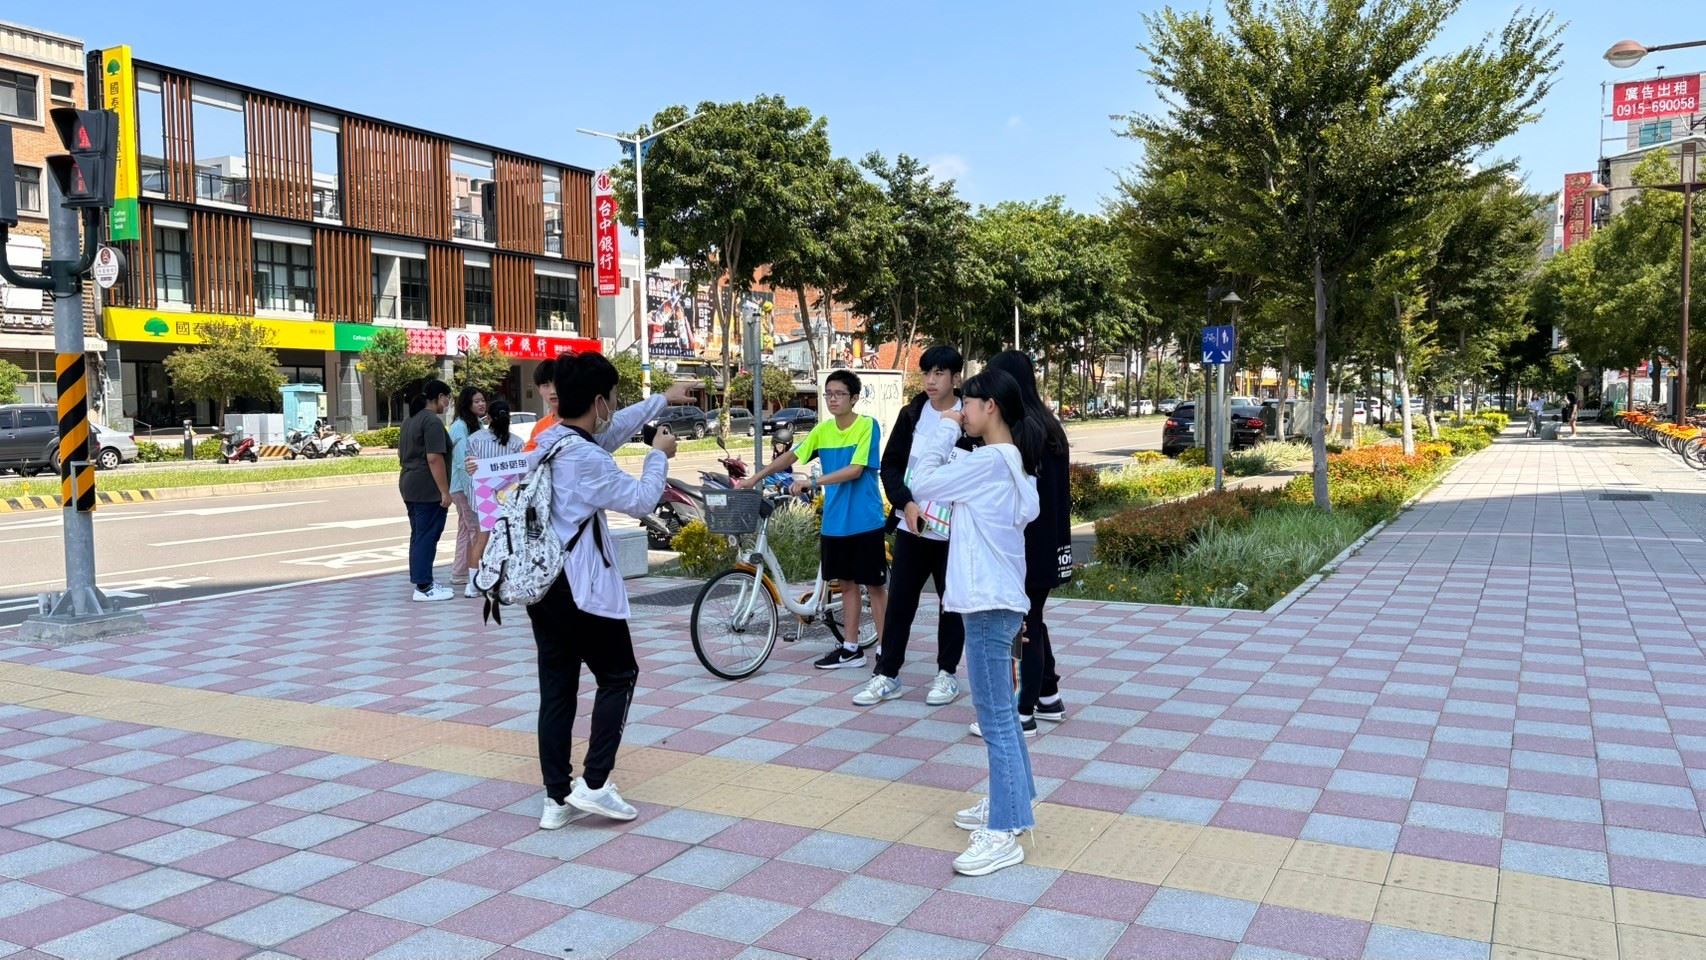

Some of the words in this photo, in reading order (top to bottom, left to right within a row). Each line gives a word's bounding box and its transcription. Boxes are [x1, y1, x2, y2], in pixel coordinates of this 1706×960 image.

[1624, 81, 1687, 101] 廣告出租
[1616, 97, 1695, 116] 0915-690058
[598, 200, 614, 271] 台中銀行
[488, 335, 547, 353] 台中銀行
